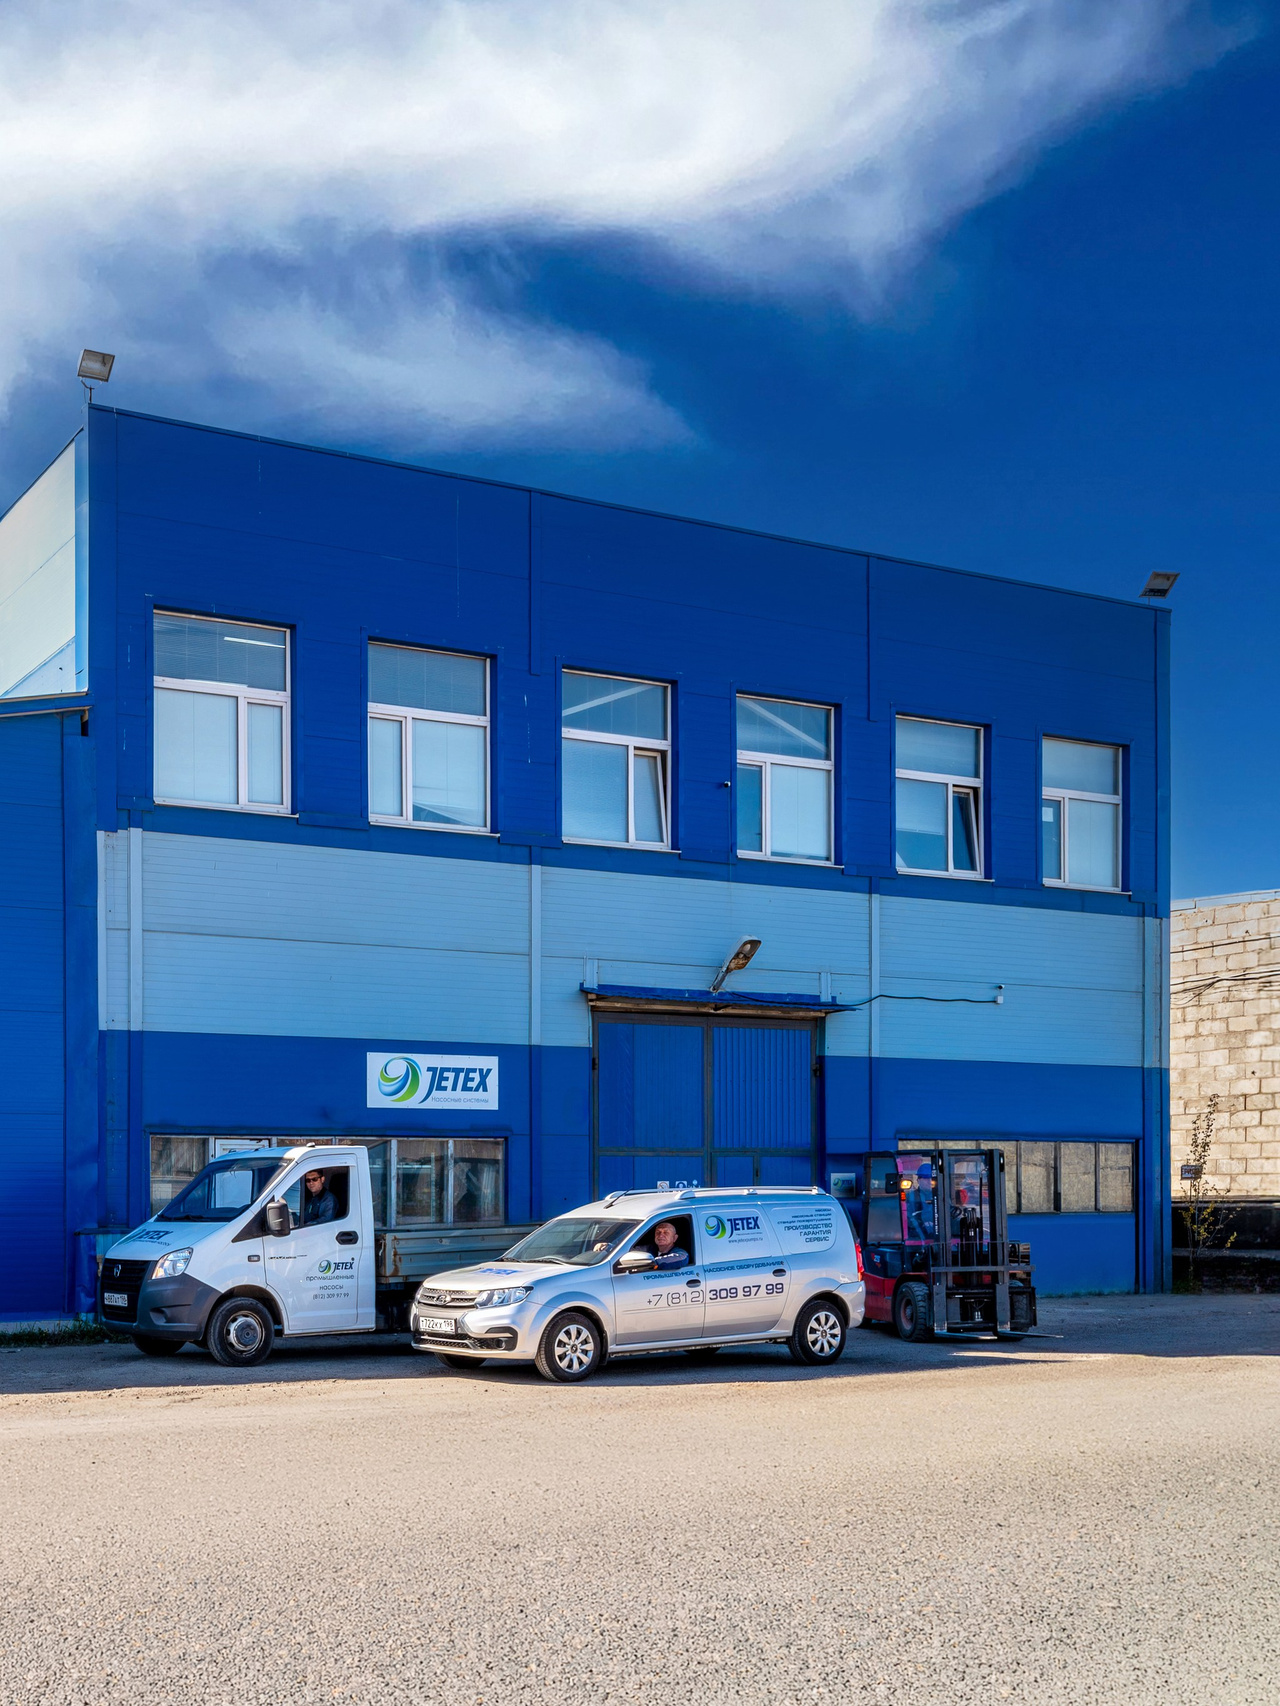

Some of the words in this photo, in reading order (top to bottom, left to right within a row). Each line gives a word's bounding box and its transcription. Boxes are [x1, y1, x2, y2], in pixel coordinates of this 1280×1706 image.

[418, 1066, 493, 1104] JETEX
[726, 1216, 761, 1239] JETEX
[783, 1222, 833, 1231] ПРОИЗВОДСТВО
[799, 1229, 832, 1237] ГАРАНТИЯ
[331, 1261, 355, 1275] JETEX
[642, 1270, 696, 1280] ПРОМЫШЛЕННОЕ
[704, 1265, 736, 1274] НАСОСНОЕ
[736, 1261, 781, 1270] ОБОРУДОВАНИЕ
[305, 1274, 355, 1282] промышленные
[312, 1292, 326, 1300] (812)
[647, 1294, 663, 1307] +7
[666, 1290, 705, 1307] (812)
[708, 1287, 738, 1301] 309
[742, 1285, 761, 1298] 97
[765, 1283, 784, 1295] 99
